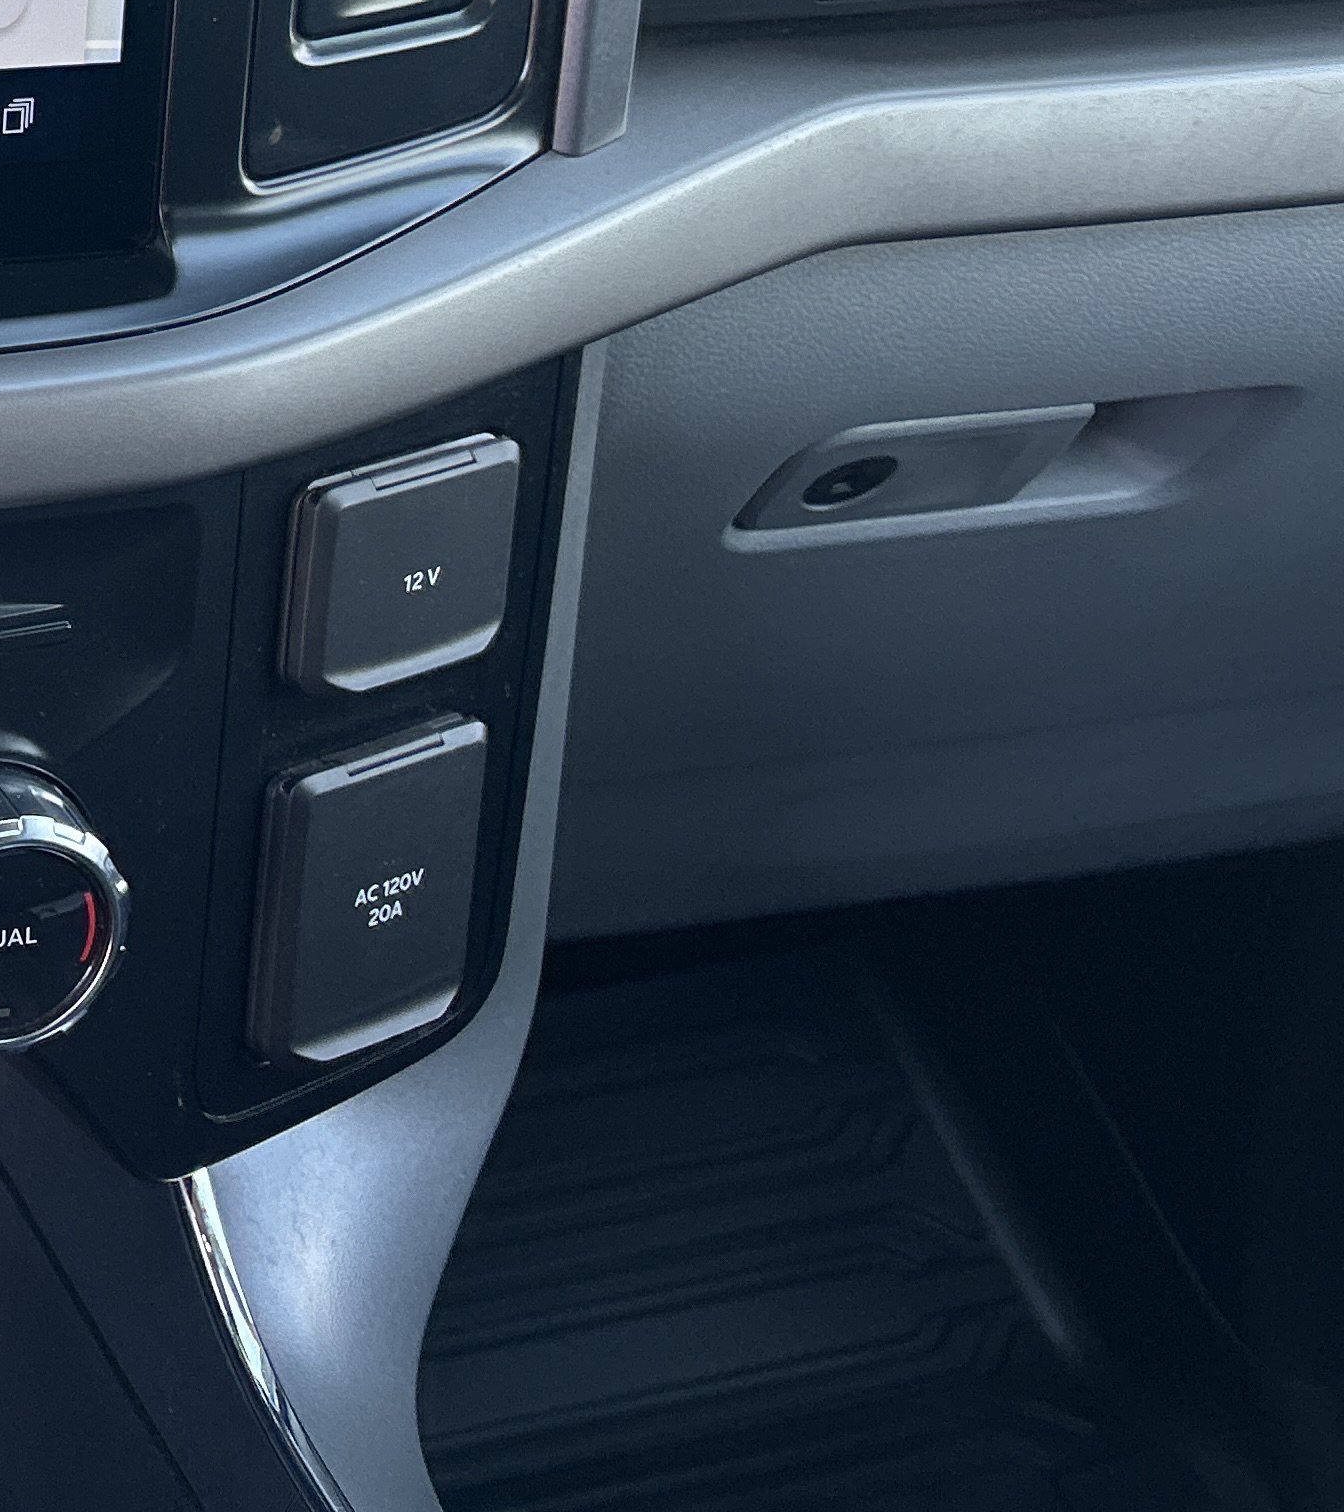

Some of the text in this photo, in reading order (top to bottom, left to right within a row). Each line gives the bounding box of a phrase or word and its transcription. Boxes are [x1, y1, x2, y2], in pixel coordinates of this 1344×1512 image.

[403, 566, 442, 593] 12 V
[354, 868, 424, 907] AC 120V
[368, 901, 403, 928] 20A
